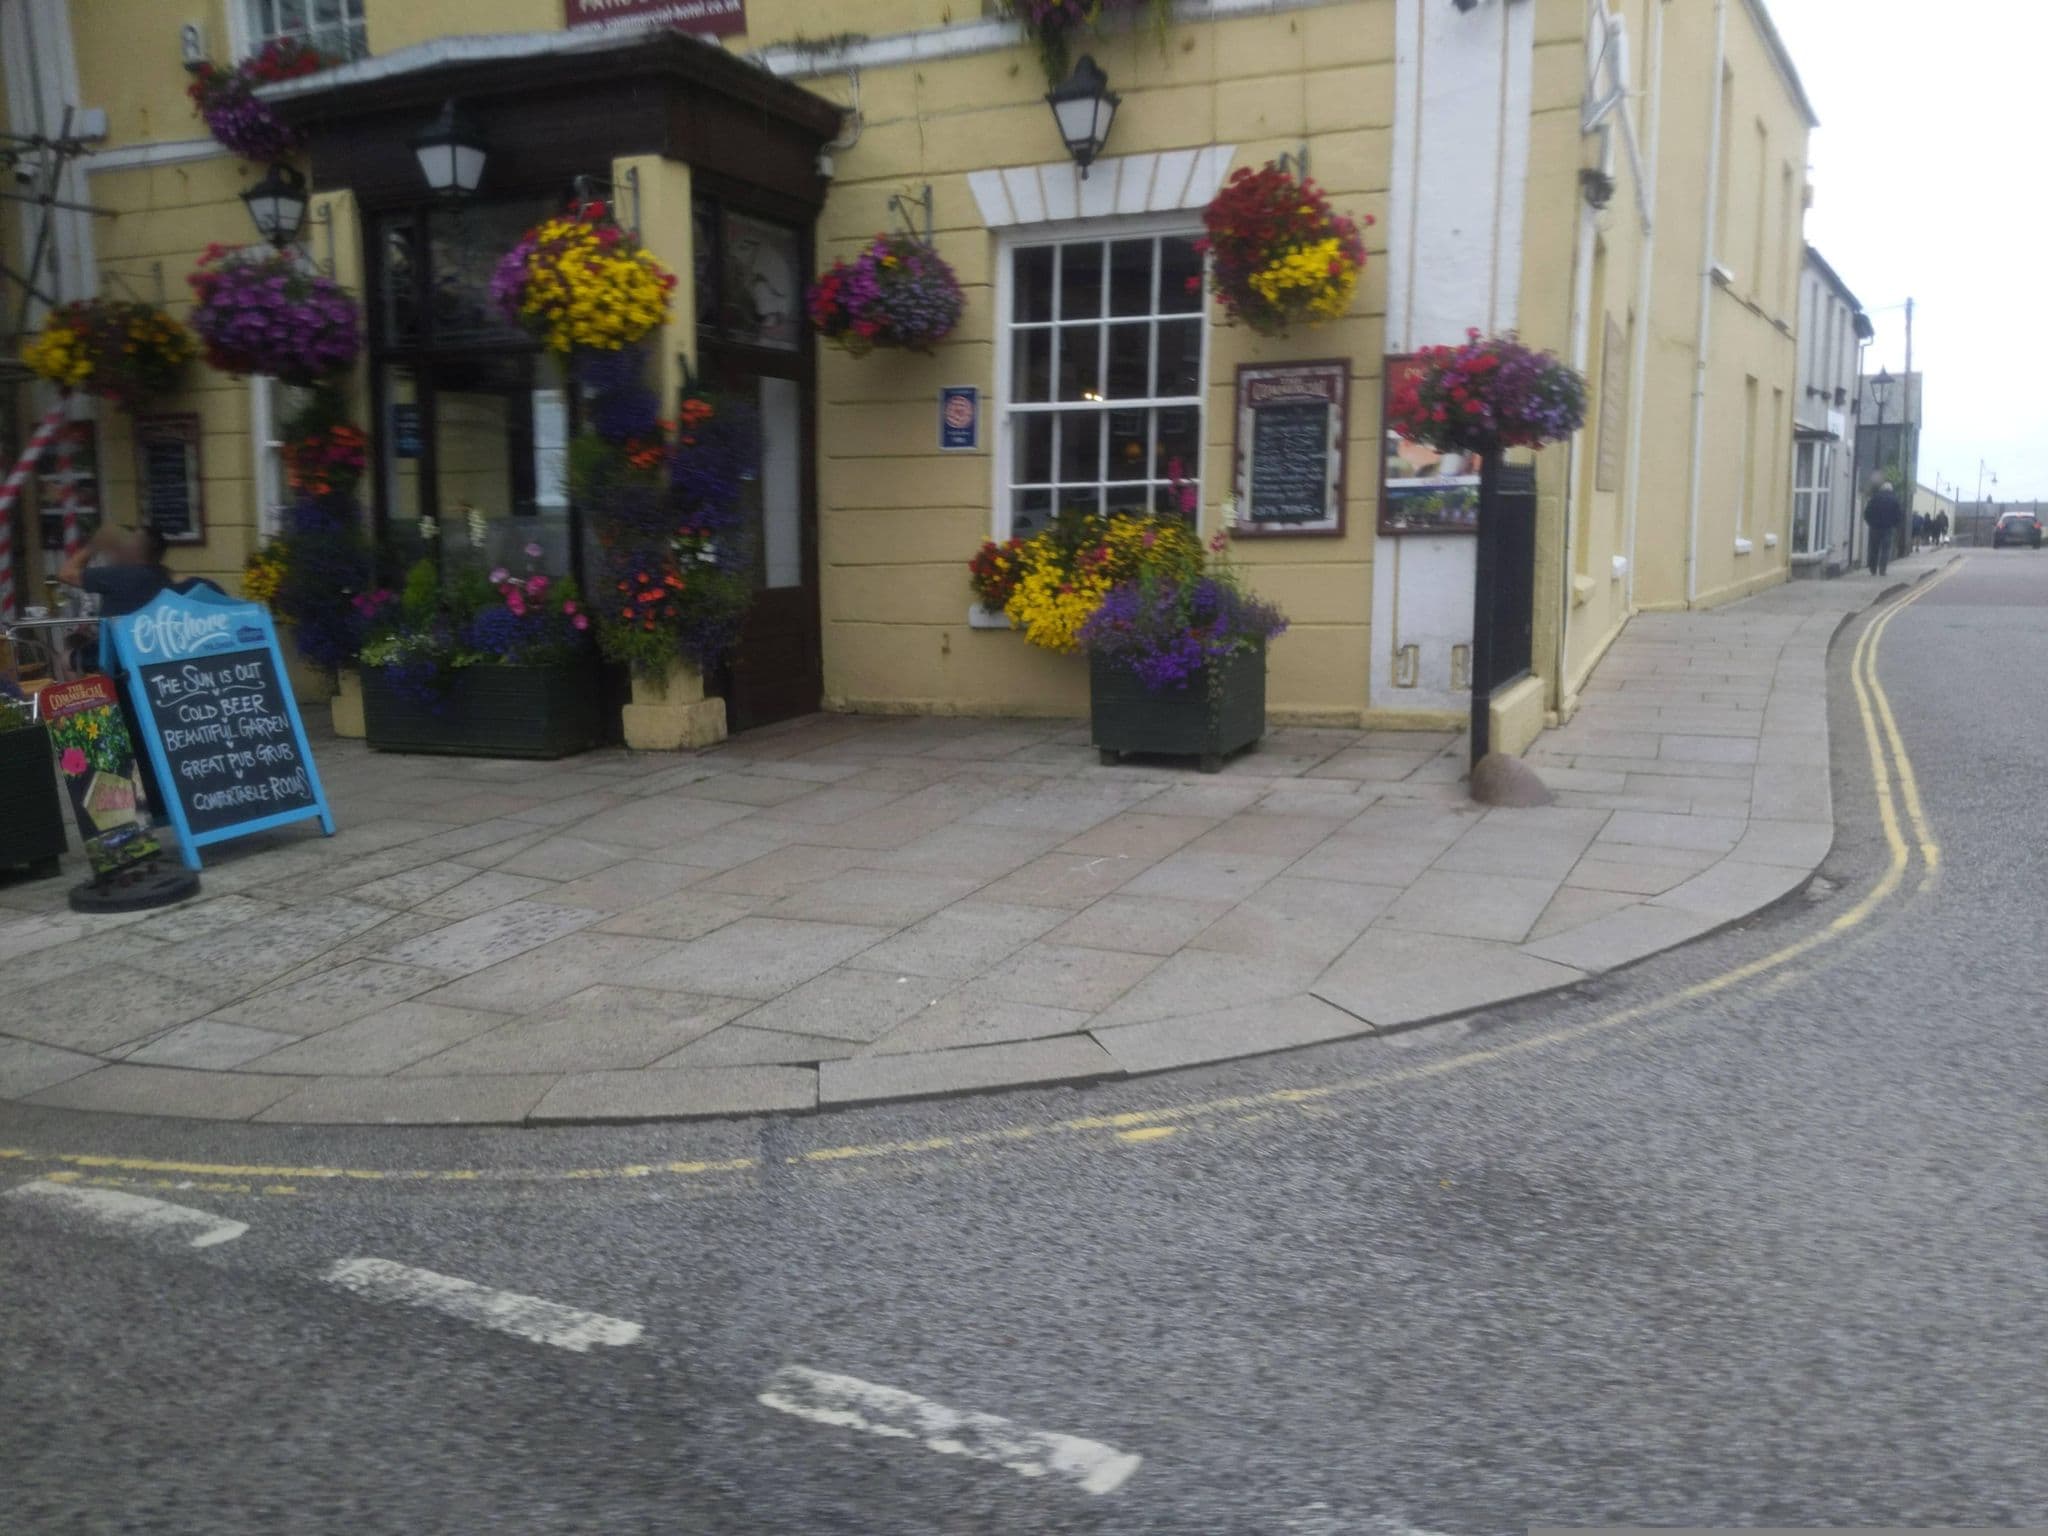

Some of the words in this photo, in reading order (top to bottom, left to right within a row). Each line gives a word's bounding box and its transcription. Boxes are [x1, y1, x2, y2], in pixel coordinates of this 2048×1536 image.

[151, 674, 182, 698] THE
[182, 664, 215, 692] SUN
[219, 670, 233, 684] IS
[235, 661, 263, 680] OUT
[179, 703, 219, 723] COLD
[220, 694, 268, 717] BEER
[164, 721, 240, 752] BEAUTIFUL
[239, 712, 290, 738] GARDEN
[181, 755, 226, 780] GREAT
[228, 750, 256, 770] PUB
[256, 742, 295, 766] GRUB
[270, 766, 312, 801] ROOMS
